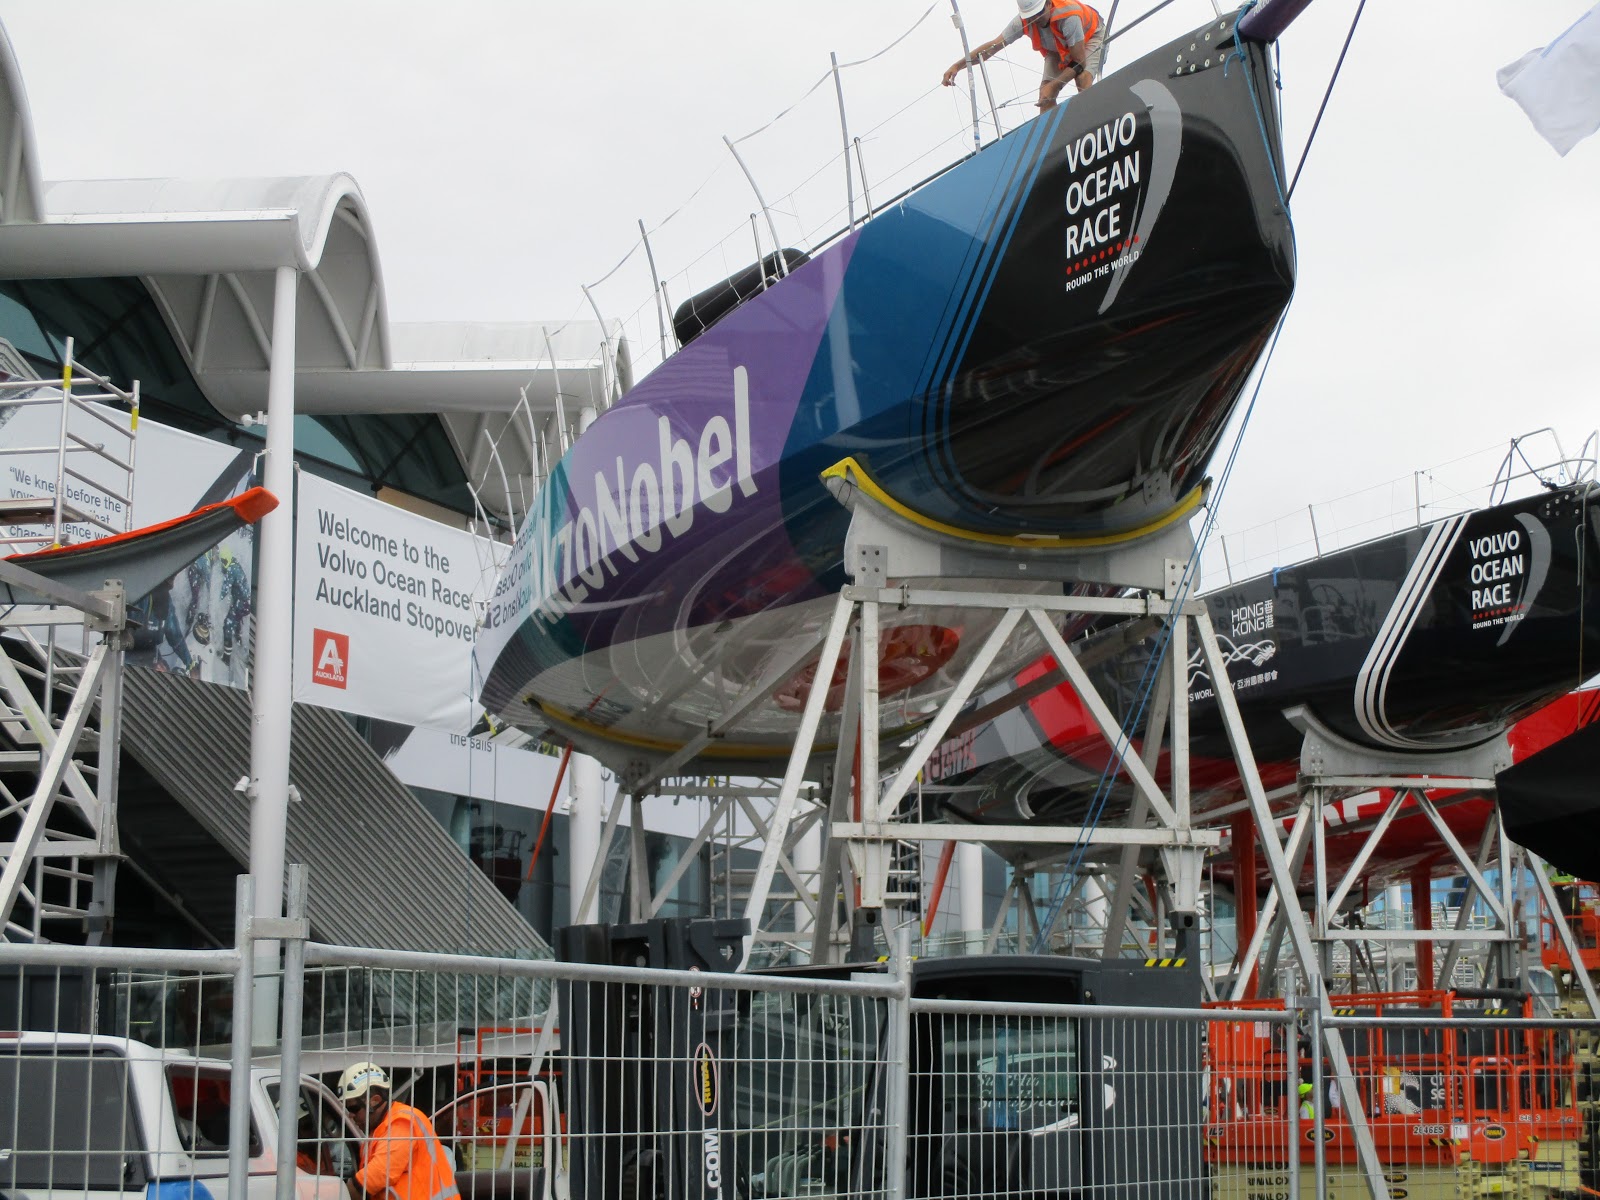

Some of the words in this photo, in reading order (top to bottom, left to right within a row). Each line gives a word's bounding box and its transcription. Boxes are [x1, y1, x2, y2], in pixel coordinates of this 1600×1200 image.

[1065, 112, 1137, 174] VOLVO
[1066, 150, 1140, 215] OCEAN
[1066, 202, 1121, 259] RACE
[1065, 271, 1093, 292] ROUND
[1094, 263, 1110, 279] THE
[1111, 250, 1140, 270] WORLD
[34, 474, 58, 493] kne
[66, 484, 101, 507] before
[103, 496, 122, 513] the
[317, 508, 398, 557] Welcome
[402, 538, 419, 564] to
[424, 547, 450, 574] the
[1469, 530, 1520, 559] VOLVO
[317, 541, 367, 580] Volvo
[372, 560, 426, 598] Ocean
[431, 578, 471, 611] Race
[1471, 554, 1523, 584] OCEAN
[315, 577, 401, 623] Auckland
[406, 602, 477, 644] Stopover
[1231, 601, 1264, 624] HONG
[1471, 583, 1511, 610] RACE
[1232, 617, 1265, 638] KONG
[1472, 620, 1492, 630] ROUND
[1492, 617, 1504, 626] THE
[1504, 613, 1525, 623] WORLD
[315, 670, 344, 682] AUCKLAND
[1194, 688, 1215, 701] WORL
